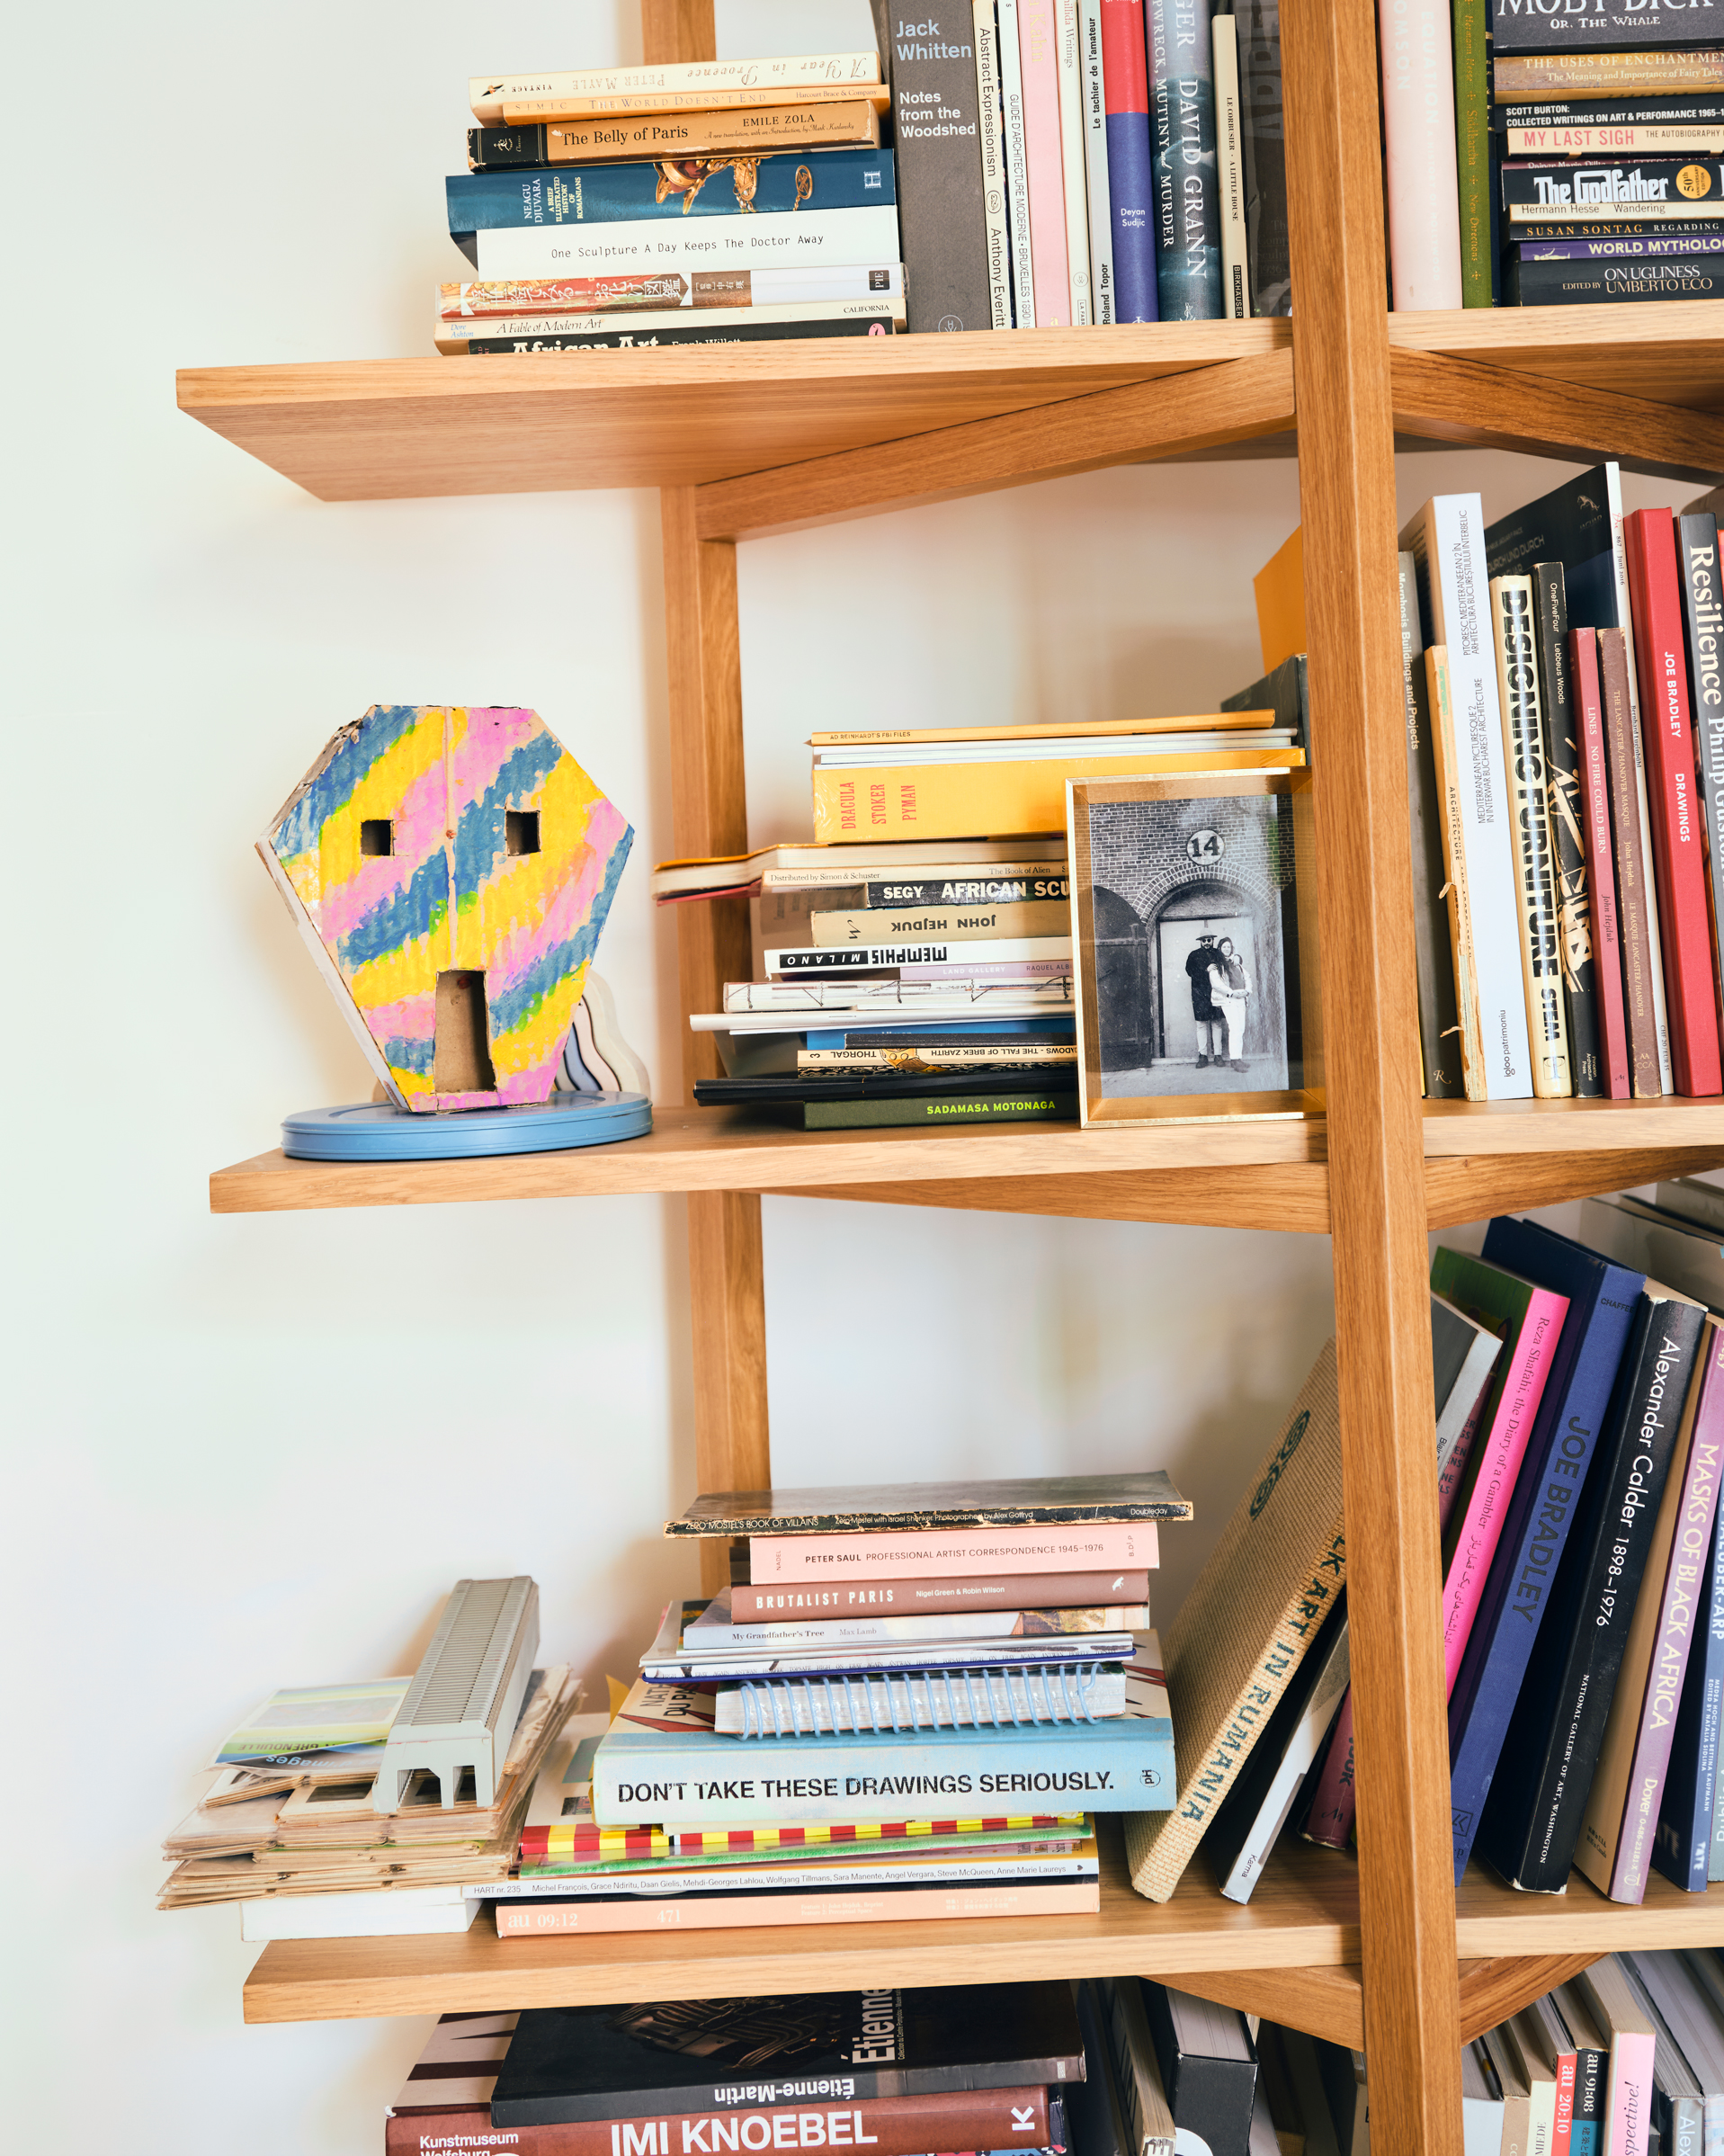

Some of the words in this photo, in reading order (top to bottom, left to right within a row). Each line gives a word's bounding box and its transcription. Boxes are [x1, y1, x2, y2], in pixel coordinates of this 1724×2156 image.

[897, 19, 940, 38] Jack
[1577, 17, 1608, 28] THE
[1612, 15, 1661, 26] WHALE
[1089, 17, 1097, 60] l'amateur
[898, 42, 972, 61] Whitten
[979, 28, 992, 83] Abstract
[572, 76, 618, 90] MAYLE
[624, 74, 665, 86] PETER
[1090, 66, 1098, 76] de
[515, 101, 568, 112] SIMIC
[589, 99, 616, 110] THE
[621, 96, 669, 109] WORLD
[674, 94, 733, 106] DOESN'T
[739, 92, 766, 103] END
[899, 92, 942, 104] Notes
[1091, 82, 1100, 114] tachier
[1227, 96, 1233, 104] LE
[1506, 106, 1532, 116] SCOTT
[1534, 104, 1570, 115] BURTON:
[743, 116, 780, 127] EMILE
[784, 113, 815, 124] ZOLA
[900, 109, 933, 121] from
[938, 106, 961, 119] the
[1093, 119, 1101, 130] Le
[1156, 77, 1170, 148] MUTINY
[1179, 79, 1203, 166] DAVID
[562, 133, 588, 146] The
[594, 130, 628, 145] Belly
[633, 128, 648, 141] of
[652, 126, 688, 139] Paris
[901, 122, 976, 139] Woodshed
[982, 85, 997, 176] Expressionism
[1227, 105, 1235, 151] CORBUSIER
[1524, 131, 1547, 147] MY
[1554, 130, 1593, 146] LAST
[1599, 130, 1635, 146] SIGH
[1160, 150, 1173, 169] and
[1533, 176, 1572, 204] The
[1573, 168, 1669, 204] Godfather
[1684, 171, 1694, 192] 50th
[523, 183, 532, 219] NEAGU
[532, 178, 543, 223] DJUVARA
[1160, 174, 1175, 248] MURDER
[1522, 204, 1567, 214] Hermann
[1570, 204, 1600, 214] Hesse
[1613, 203, 1666, 215] Wandering
[1121, 208, 1146, 218] Deyan
[1122, 219, 1146, 228] Sudjic
[1184, 175, 1207, 279] GRANN
[1527, 226, 1575, 237] SUSAN
[1583, 224, 1643, 236] SONTAG
[551, 248, 571, 258] One
[578, 246, 638, 260] Sculpture
[645, 244, 651, 253] A
[657, 242, 677, 255] Day
[684, 240, 717, 253] Keeps
[724, 238, 744, 248] The
[751, 237, 791, 247] Doctor
[798, 235, 824, 246] Away
[990, 228, 1003, 282] Anthony
[1101, 264, 1111, 290] Topor
[1562, 282, 1592, 291] EDITED
[1606, 278, 1679, 293] UMBERTO
[1683, 277, 1713, 291] ECO
[1604, 268, 1628, 281] ON
[1631, 265, 1701, 279] UGLINESS
[844, 304, 889, 314] CALIFORNIA
[994, 286, 1006, 327] Everitt
[1102, 293, 1111, 325] Roland
[496, 324, 506, 334] A
[509, 322, 531, 333] Fable
[532, 323, 541, 334] of
[543, 321, 582, 331] Modern
[584, 318, 602, 329] Art
[1550, 582, 1560, 633] OneFiveFour
[1689, 543, 1724, 706] Resilience
[1554, 643, 1563, 676] Lebbeus
[1665, 651, 1675, 675] JOE
[1501, 589, 1542, 783] DESIGNING
[1587, 707, 1597, 735] LINES
[1666, 680, 1682, 738] BRADLEY
[1591, 746, 1599, 761] NO
[1593, 764, 1602, 786] FIRE
[840, 781, 856, 829] DRACULA
[871, 783, 886, 825] STOKER
[901, 784, 917, 821] PYMAN
[1594, 788, 1604, 824] COULD
[1675, 774, 1690, 842] DRAWINGS
[1191, 836, 1220, 858] 14
[1596, 826, 1607, 854] BURN
[883, 885, 925, 899] SEGY
[941, 881, 1027, 899] AFRICAN
[1517, 788, 1559, 979] FURNITURE
[891, 917, 948, 932] HEJDUK
[957, 914, 996, 928] JOHN
[787, 953, 861, 966] MILANO
[871, 946, 947, 964] MEMPHIS
[1541, 988, 1560, 1042] STEM
[1499, 1008, 1512, 1055] patrimoniu
[830, 1050, 878, 1060] THORGAL
[1502, 1056, 1516, 1078] igloo
[926, 1103, 989, 1115] SADAMASA
[992, 1100, 1056, 1113] MOTONAGA
[1532, 1316, 1550, 1346] Reza
[1516, 1348, 1541, 1394] Shafahi,
[1639, 1336, 1682, 1448] Alexander
[1511, 1398, 1525, 1416] the
[1500, 1418, 1520, 1452] Diary
[1553, 1416, 1591, 1480] JOE
[1494, 1469, 1502, 1477] a
[1496, 1454, 1507, 1471] of
[1620, 1454, 1654, 1528] Calder
[1687, 1443, 1720, 1524] MASKS
[1478, 1479, 1501, 1530] Gambler
[805, 1554, 835, 1563] PETER
[836, 1553, 862, 1562] SAUL
[866, 1551, 933, 1561] PROFESSIONAL
[935, 1549, 967, 1558] ARTIST
[969, 1545, 1056, 1557] CORRESPONDENCE
[1512, 1483, 1573, 1623] BRADLEY
[1680, 1526, 1703, 1561] OF
[755, 1592, 839, 1609] BRUTALIST
[848, 1589, 895, 1605] PARIS
[1666, 1563, 1698, 1638] BLACK
[731, 1632, 745, 1642] My
[804, 1629, 825, 1638] Tree
[1573, 1674, 1590, 1719] NATIONAL
[1649, 1642, 1682, 1731] AFRICA
[1564, 1722, 1578, 1762] GALLERY
[1559, 1765, 1568, 1778] OF
[618, 1782, 686, 1803] DON'T
[695, 1780, 755, 1800] TAKE
[763, 1778, 838, 1798] THESE
[845, 1775, 972, 1796] DRAWINGS
[979, 1771, 1115, 1794] SERIOUSLY.
[1552, 1781, 1564, 1801] ART,
[1540, 1803, 1559, 1864] WASHINGTON
[507, 1913, 531, 1928] au
[538, 1913, 578, 1928] 09:12
[419, 2133, 519, 2149] Kunstmuseum
[611, 2121, 670, 2156] IMI
[682, 2110, 878, 2156] KNOEBEL
